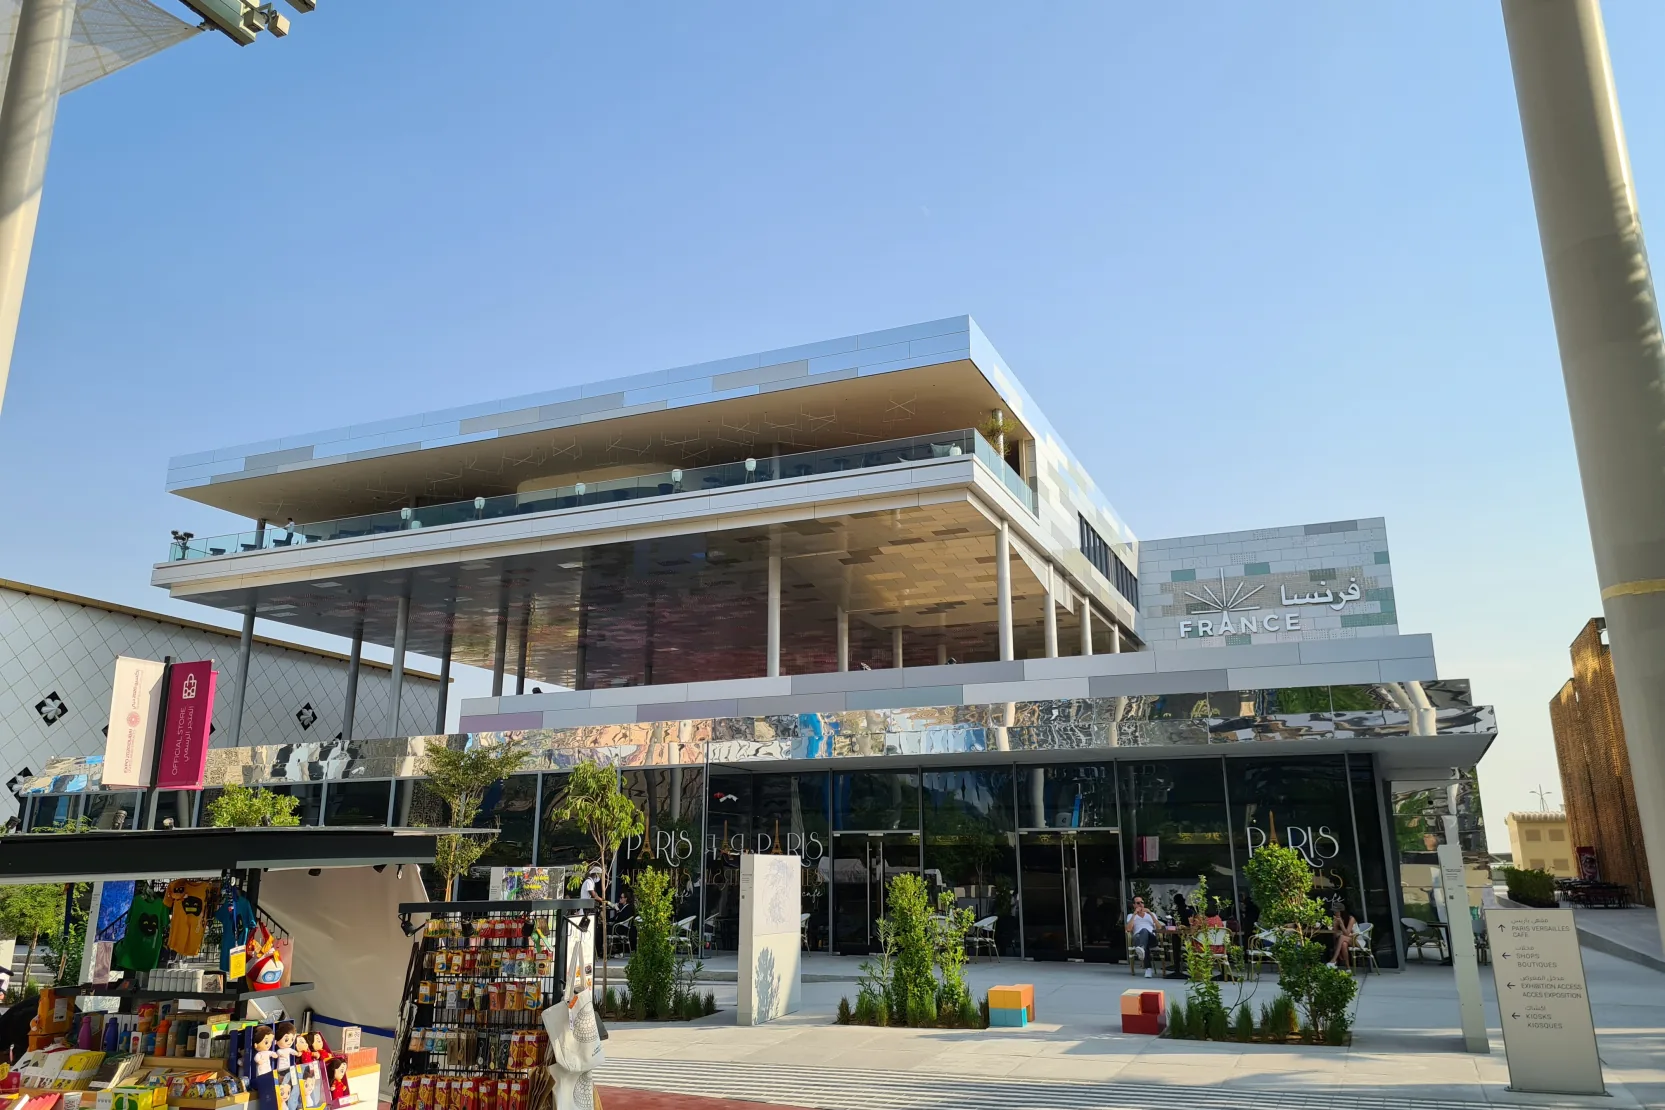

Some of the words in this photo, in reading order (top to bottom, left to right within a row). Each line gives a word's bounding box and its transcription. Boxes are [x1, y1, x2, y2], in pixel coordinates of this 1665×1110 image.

[1280, 577, 1361, 611] فرنسا
[1180, 611, 1301, 638] FRANCE
[187, 705, 195, 730] المتجر
[171, 735, 183, 776] OFFICIAL
[177, 706, 187, 735] STORE
[183, 731, 191, 763] الرسمي
[627, 816, 693, 867] PARIS
[757, 819, 824, 867] PARIS
